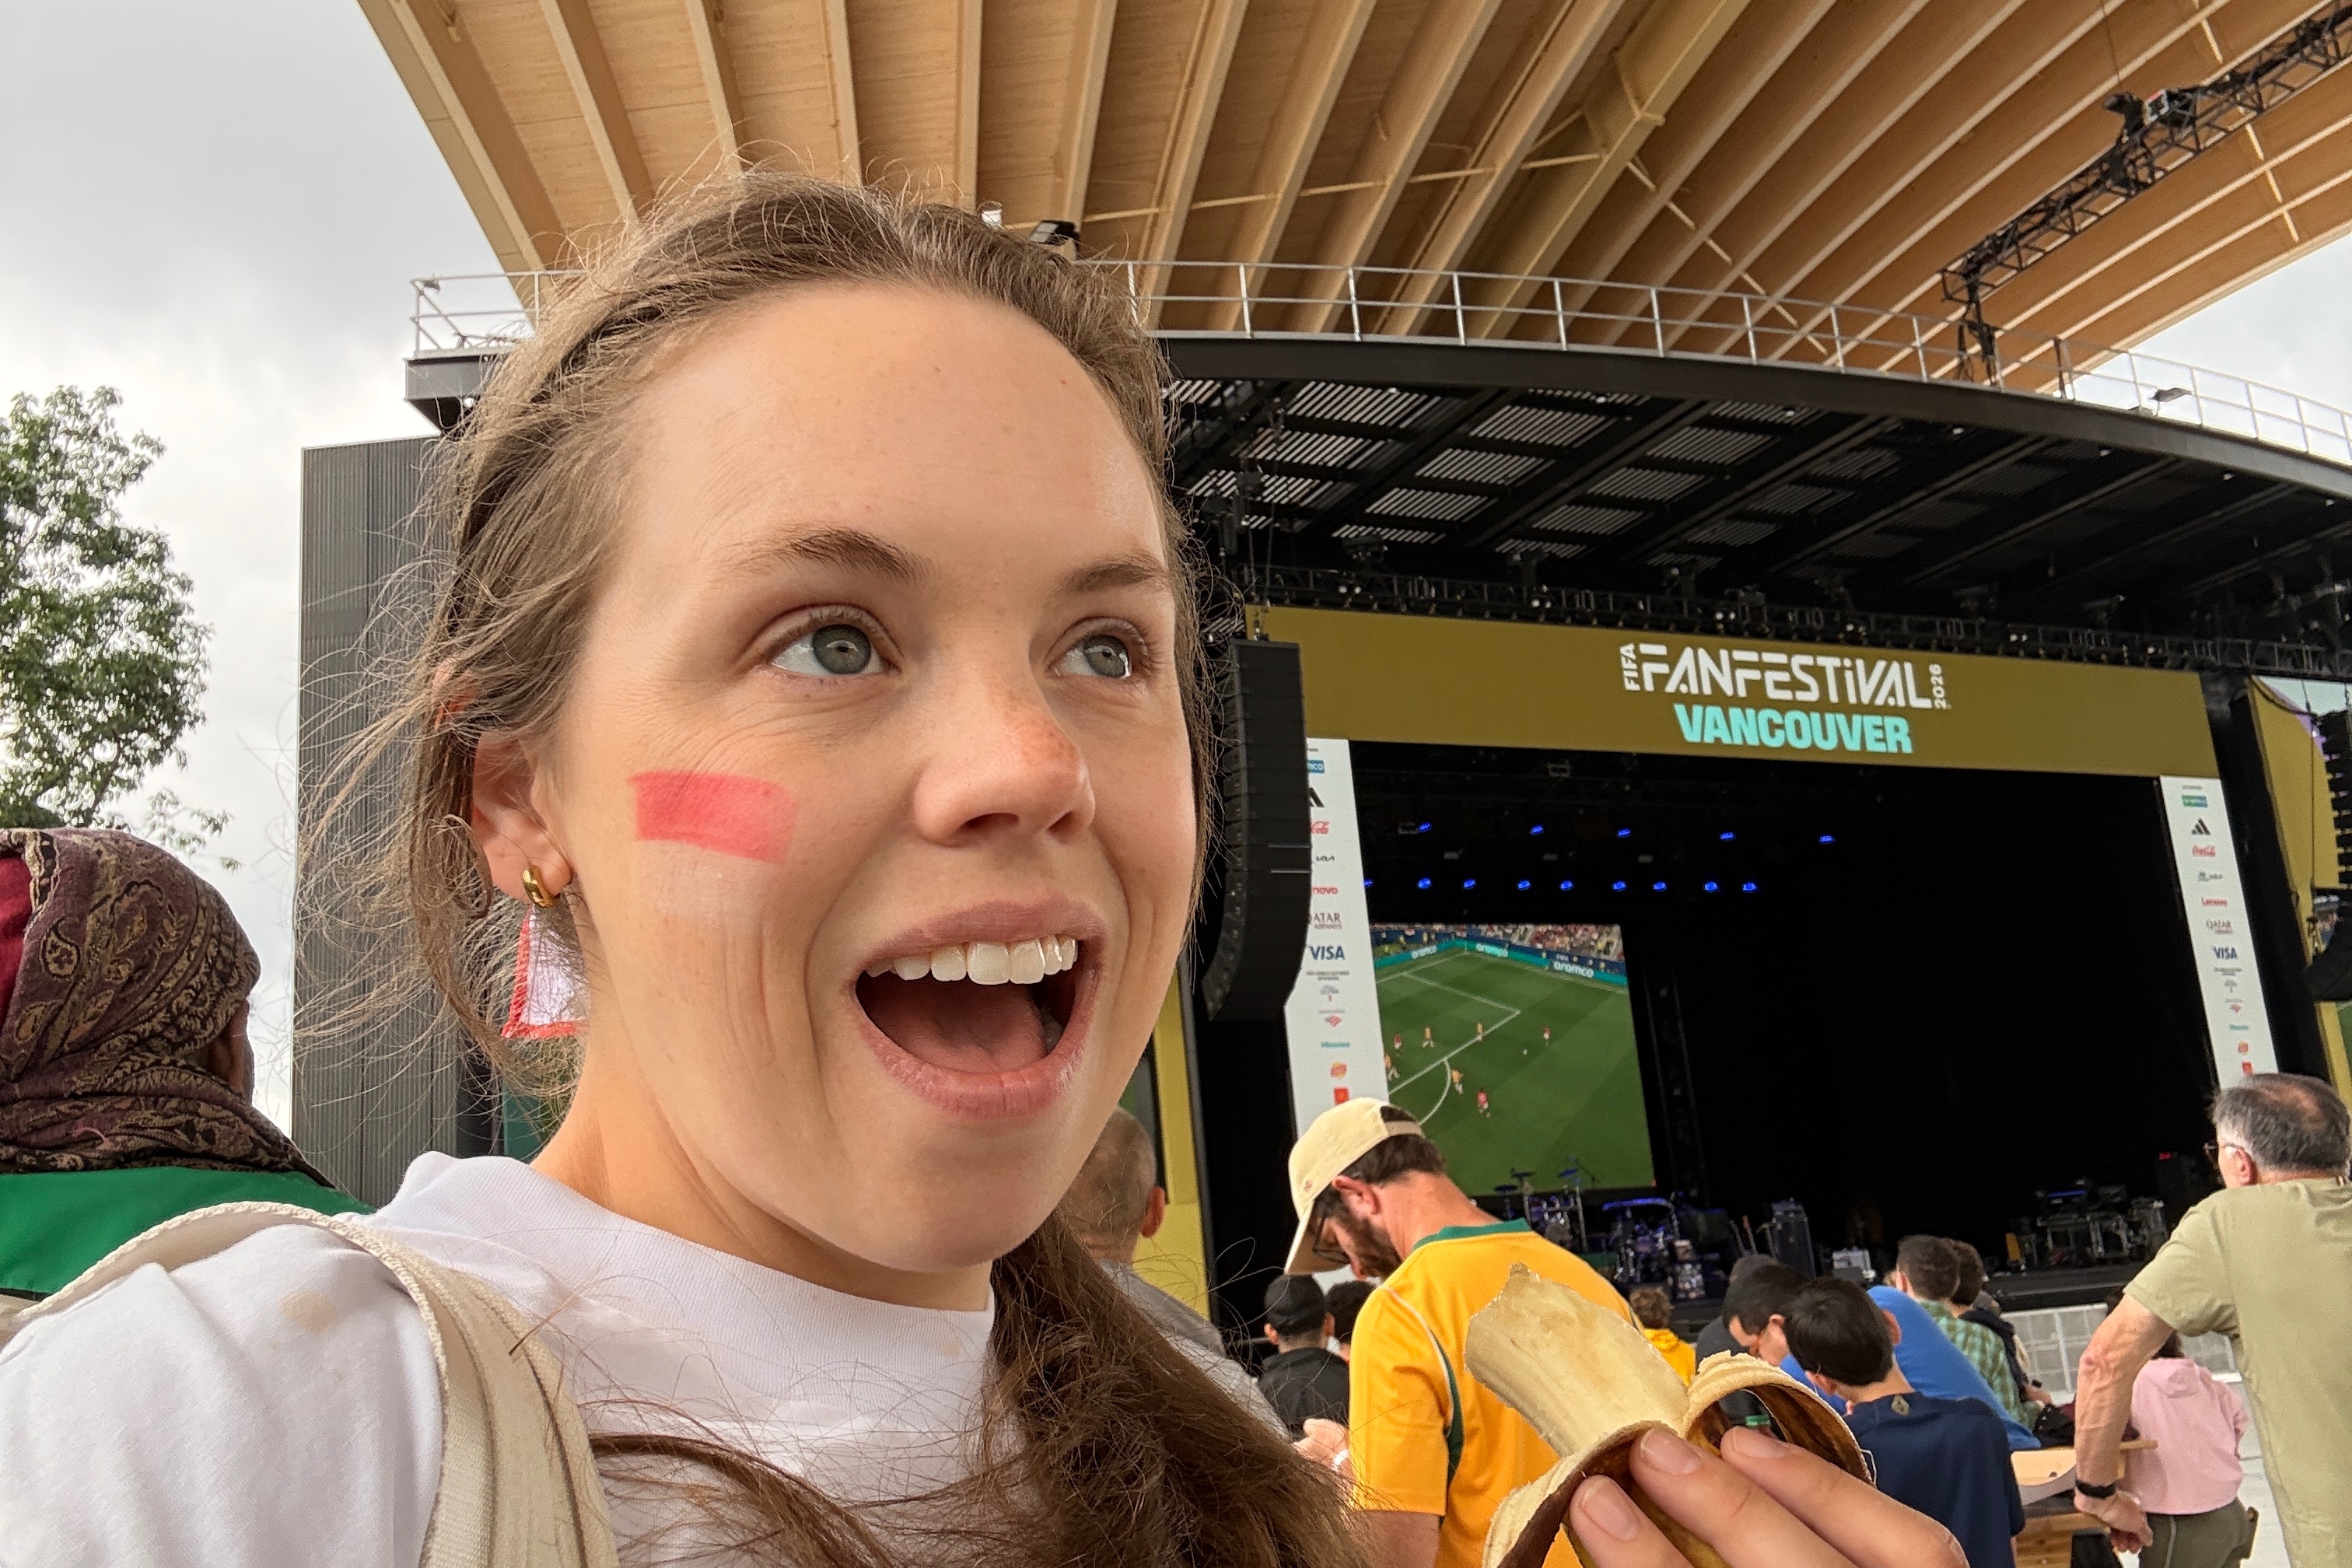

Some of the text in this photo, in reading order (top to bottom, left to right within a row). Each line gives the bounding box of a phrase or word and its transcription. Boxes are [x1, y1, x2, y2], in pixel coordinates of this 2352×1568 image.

[1619, 642, 1641, 691] FIFA
[1929, 663, 1947, 709] 2026
[1673, 703, 1913, 754] VANCOUVER
[1310, 912, 1342, 923] ATAR
[1309, 945, 1346, 961] VISA
[2213, 946, 2238, 960] VISA
[1553, 961, 1594, 978] aramco
